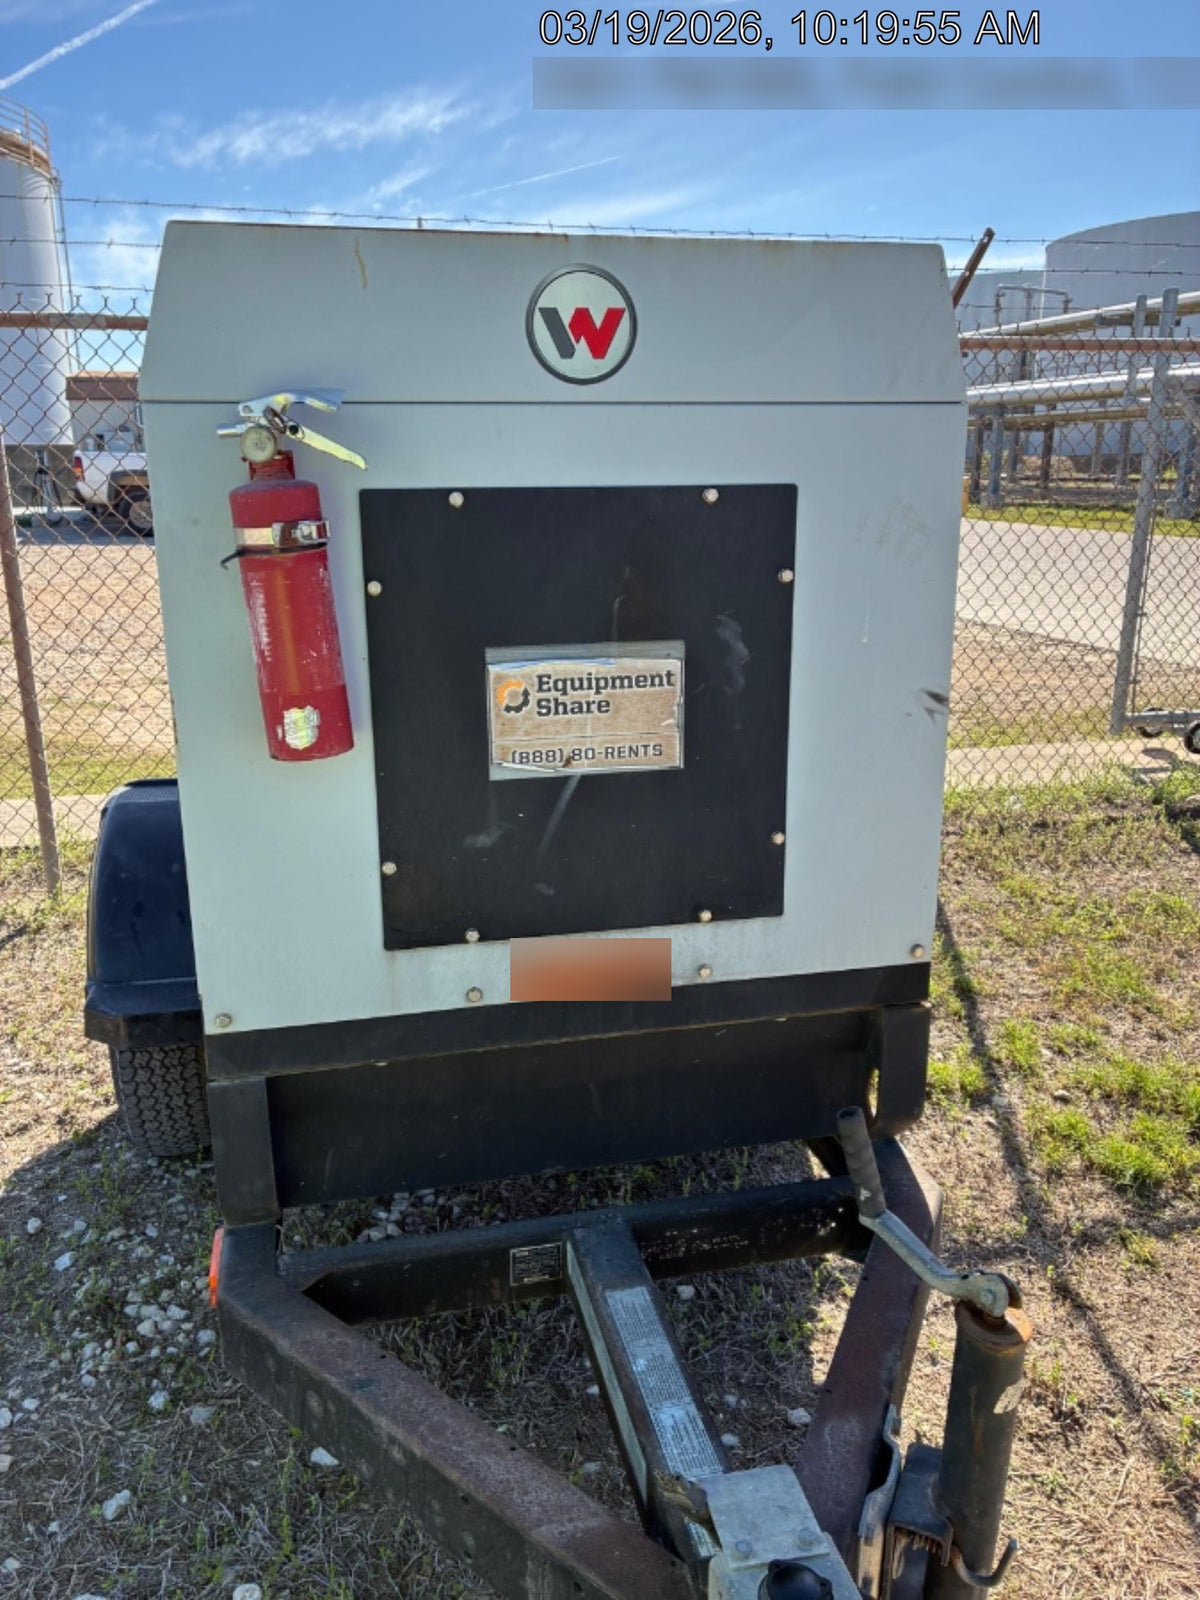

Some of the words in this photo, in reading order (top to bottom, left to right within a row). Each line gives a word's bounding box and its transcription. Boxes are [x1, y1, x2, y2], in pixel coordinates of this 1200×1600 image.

[536, 671, 675, 695] Equipment
[536, 698, 610, 717] Share
[511, 748, 564, 765] (888)
[571, 743, 663, 762] 80-RENTS
